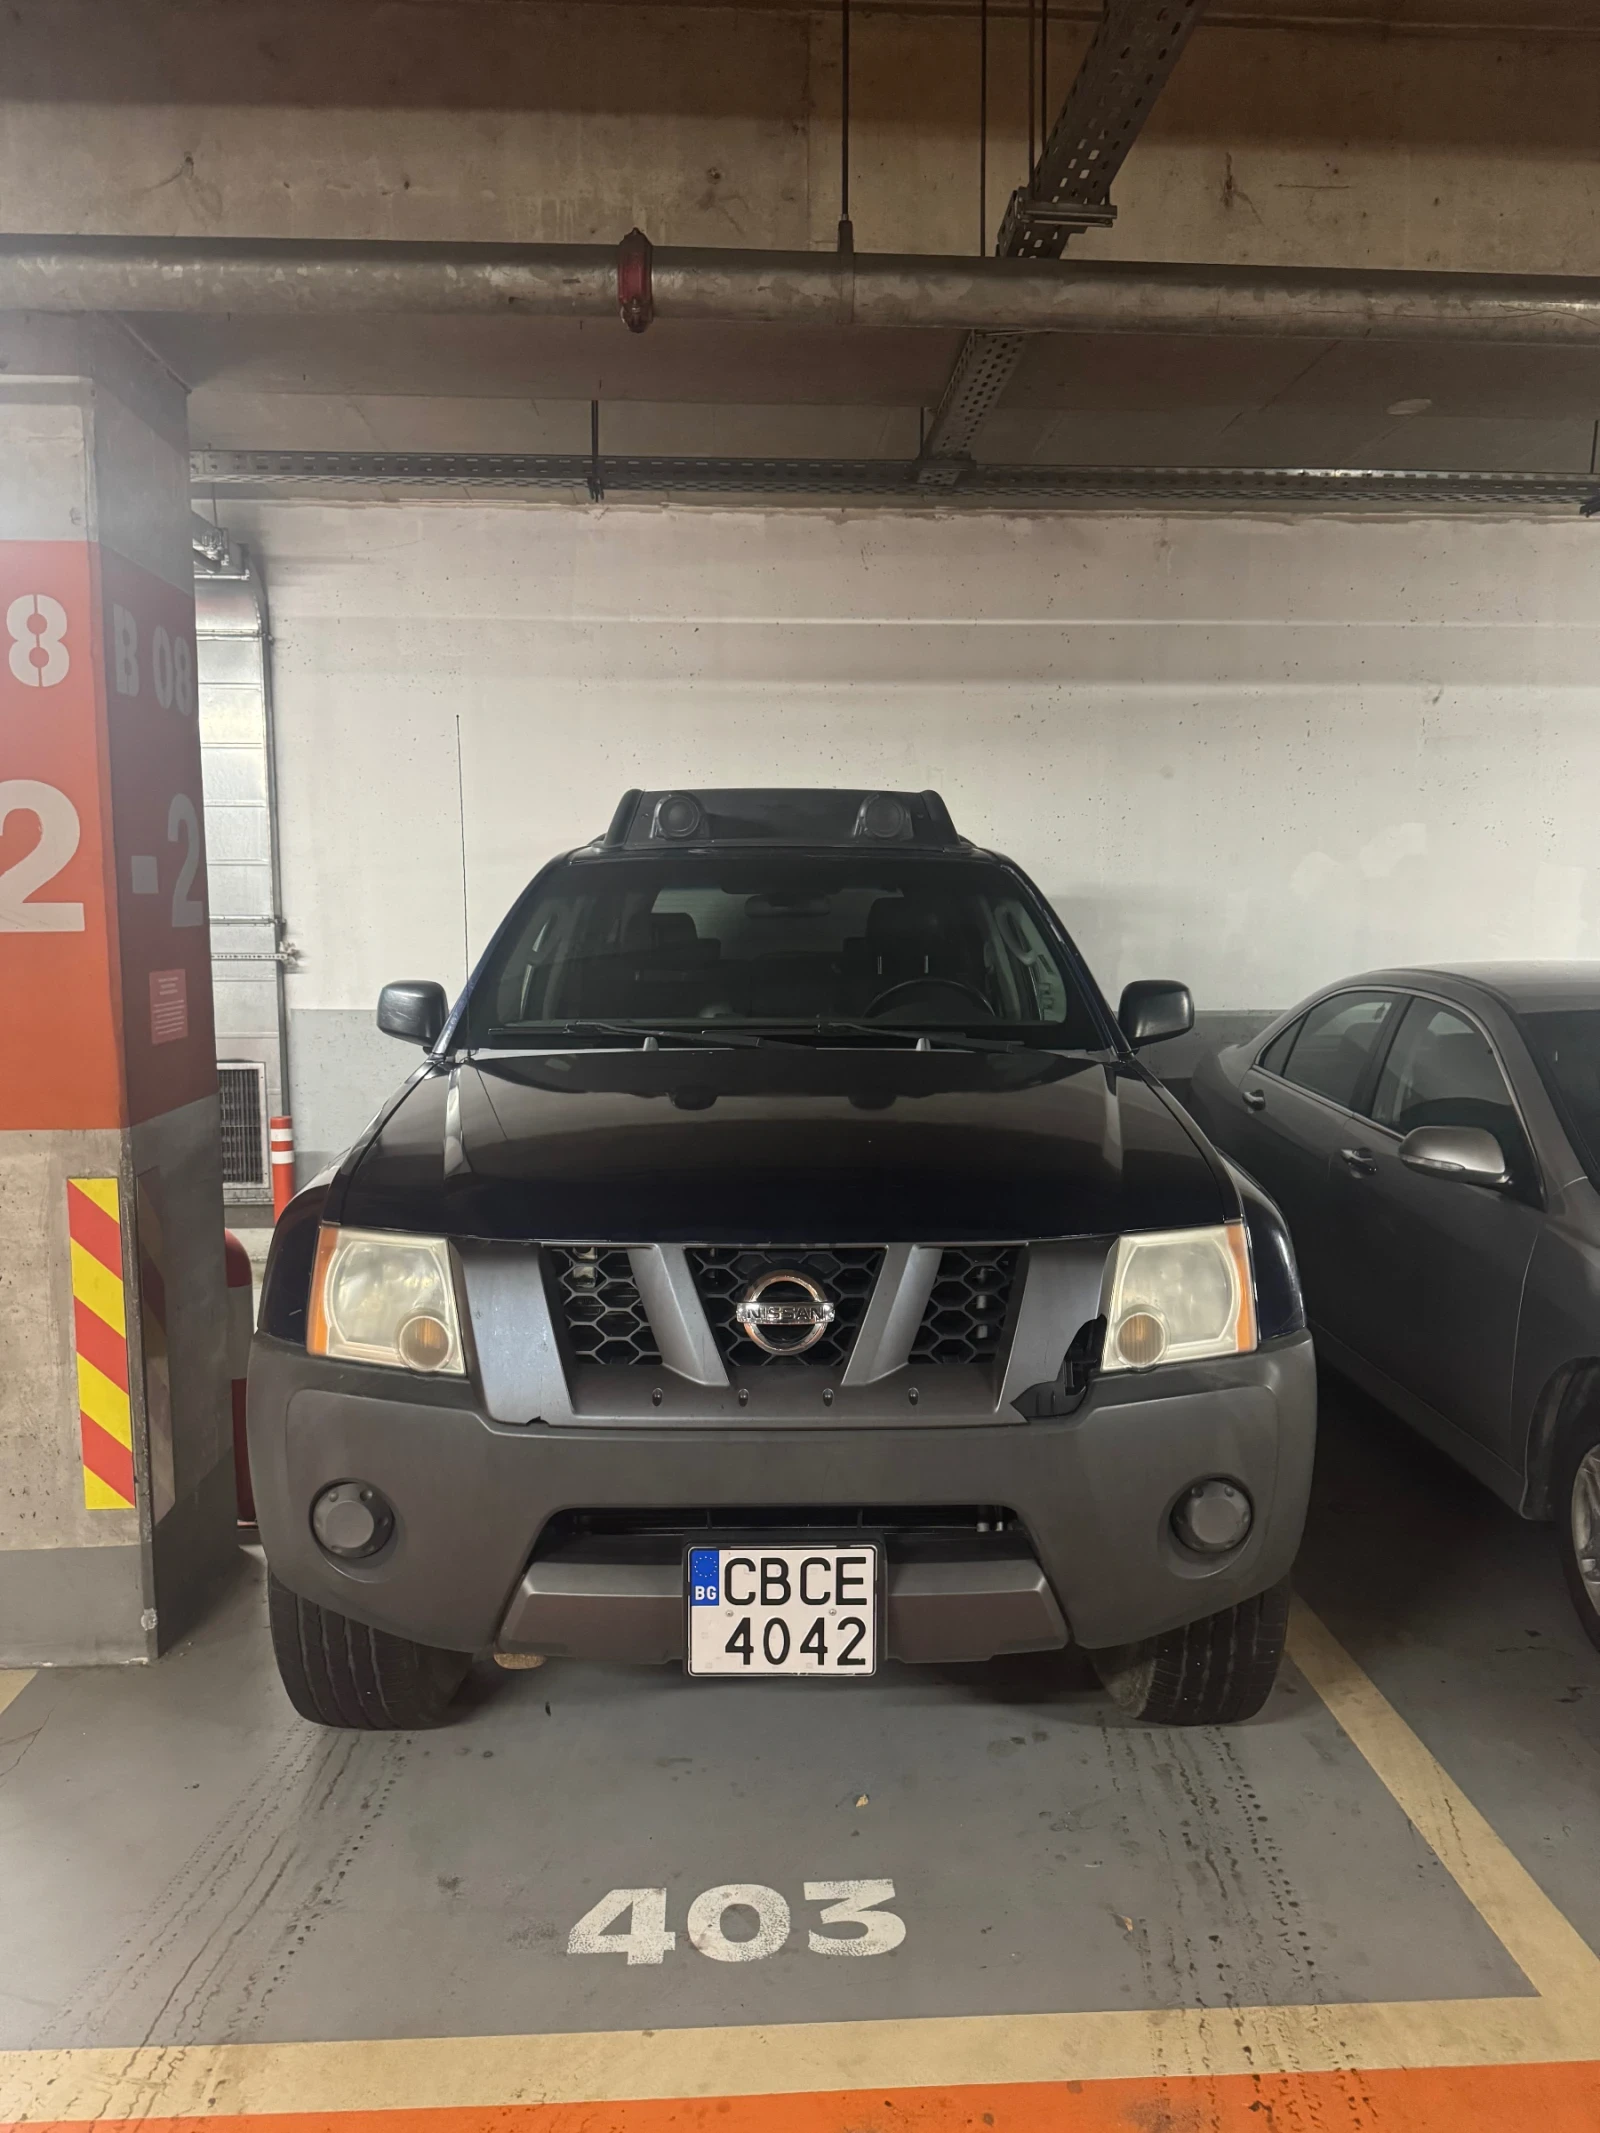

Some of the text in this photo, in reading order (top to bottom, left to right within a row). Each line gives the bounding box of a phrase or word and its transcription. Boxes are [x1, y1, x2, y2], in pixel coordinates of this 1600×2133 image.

[6, 594, 70, 687] 8
[113, 603, 193, 717] B 08
[0, 779, 86, 933] 2
[747, 1306, 825, 1321] NISSAN
[695, 1585, 717, 1601] BG
[724, 1556, 868, 1606] CBCE
[725, 1616, 867, 1666] 4042
[567, 1878, 906, 1965] 403
